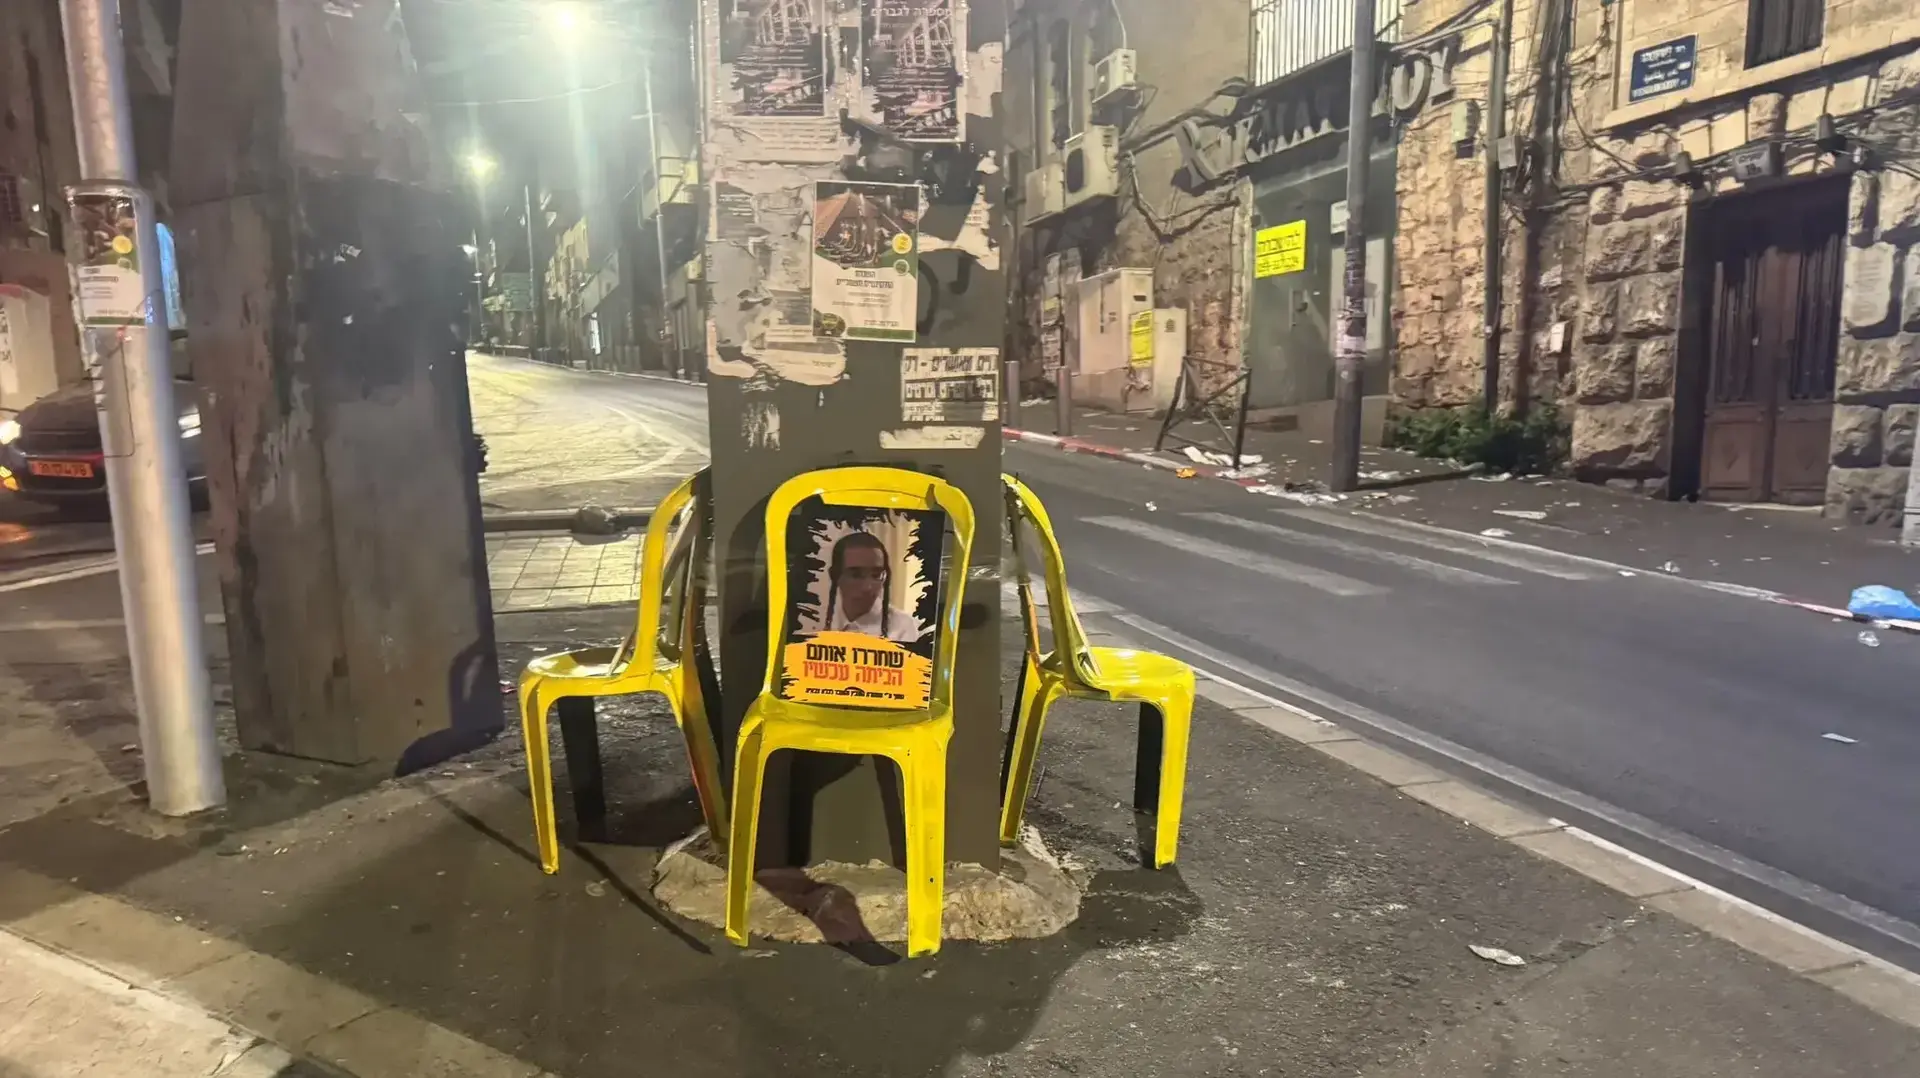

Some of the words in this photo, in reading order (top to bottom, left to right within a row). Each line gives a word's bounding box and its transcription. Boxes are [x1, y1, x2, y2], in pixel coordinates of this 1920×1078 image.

[913, 8, 952, 16] מספרה
[806, 643, 846, 663] אותם
[852, 647, 904, 668] שחררו
[803, 661, 849, 680] עכשיו
[855, 666, 903, 686] הביתה
